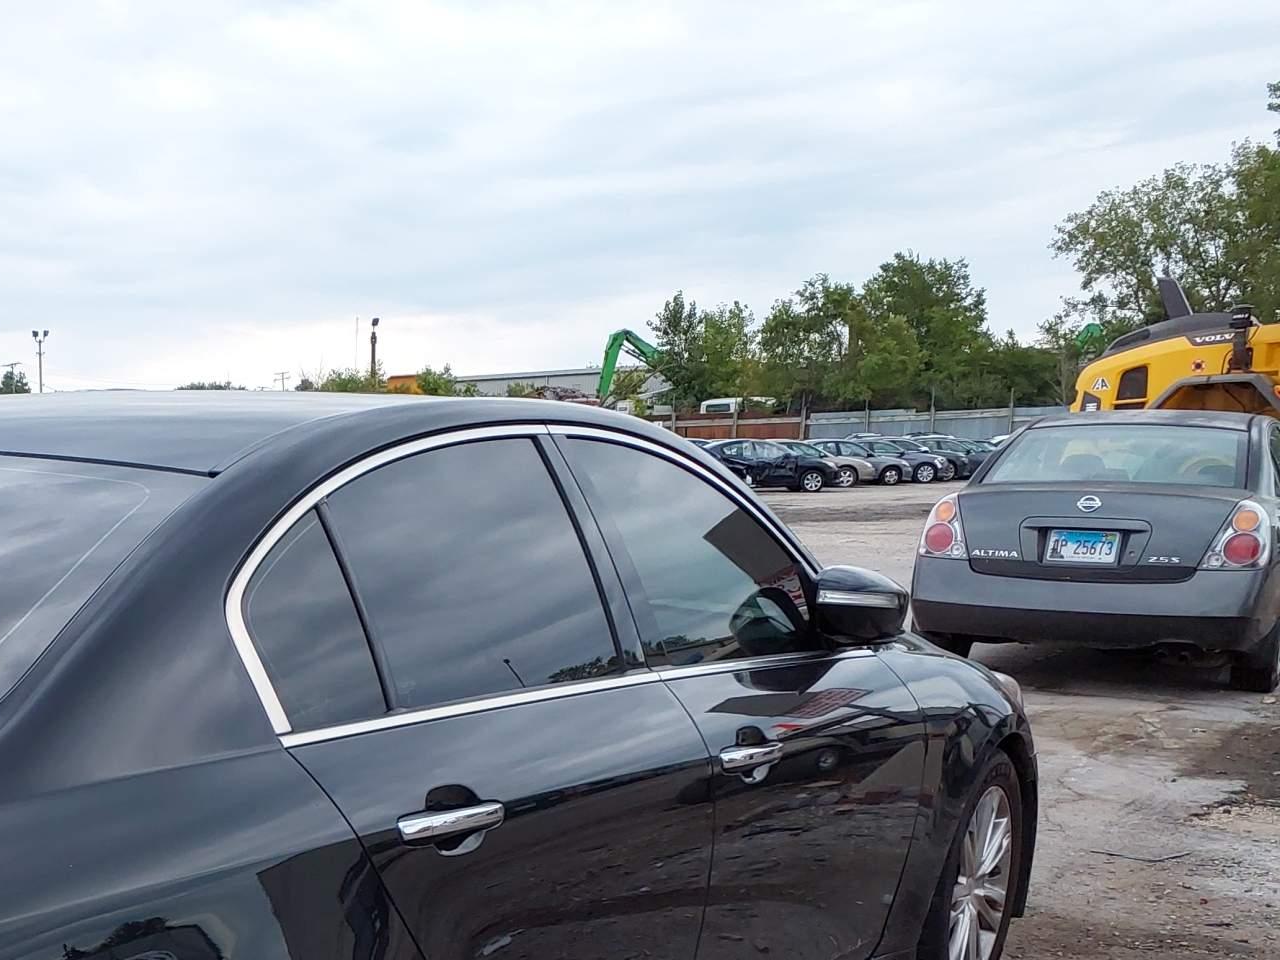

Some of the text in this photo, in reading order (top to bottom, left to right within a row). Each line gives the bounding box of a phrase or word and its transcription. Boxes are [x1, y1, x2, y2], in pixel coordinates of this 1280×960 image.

[1192, 332, 1235, 343] VOLV
[971, 549, 1019, 557] ALTIMA
[1072, 540, 1114, 556] 25673
